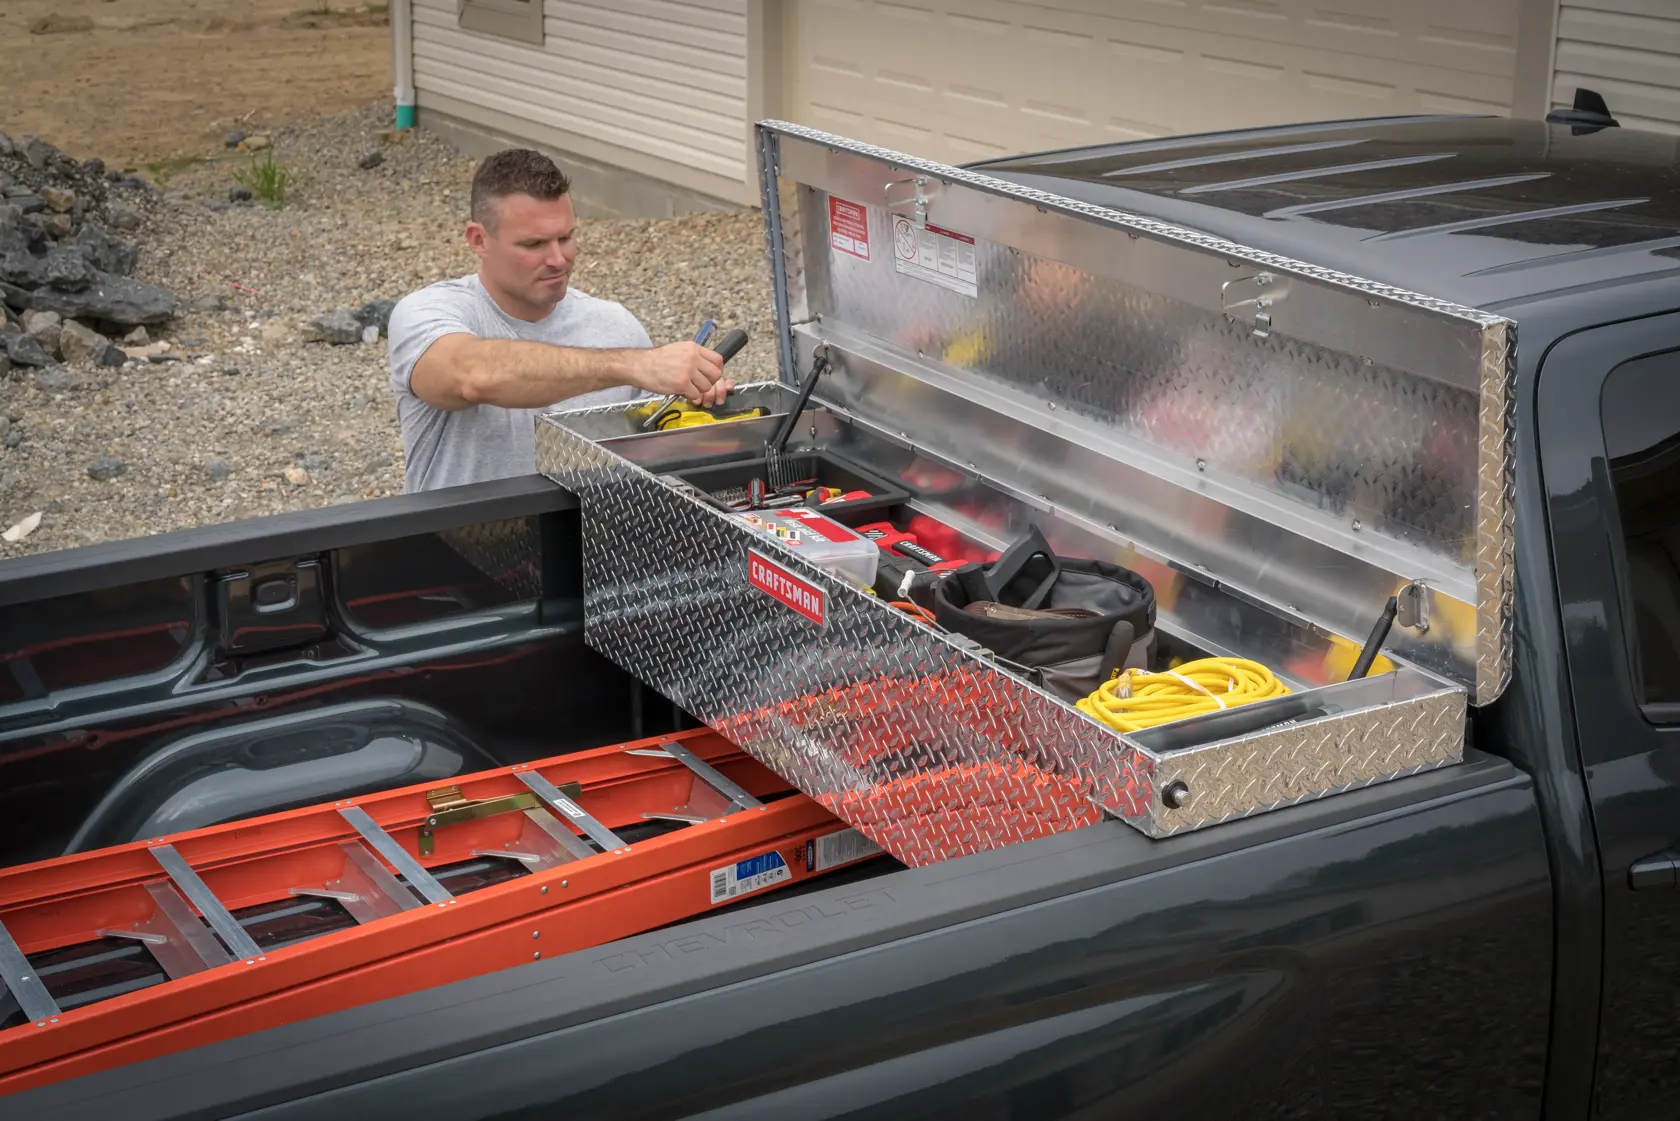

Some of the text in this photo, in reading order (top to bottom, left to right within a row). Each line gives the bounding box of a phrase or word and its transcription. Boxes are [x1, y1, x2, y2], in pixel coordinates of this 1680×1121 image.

[900, 540, 943, 562] CRAFTSMAN
[752, 561, 820, 616] CRAFTSMAN
[592, 886, 898, 974] CHEVROLET
